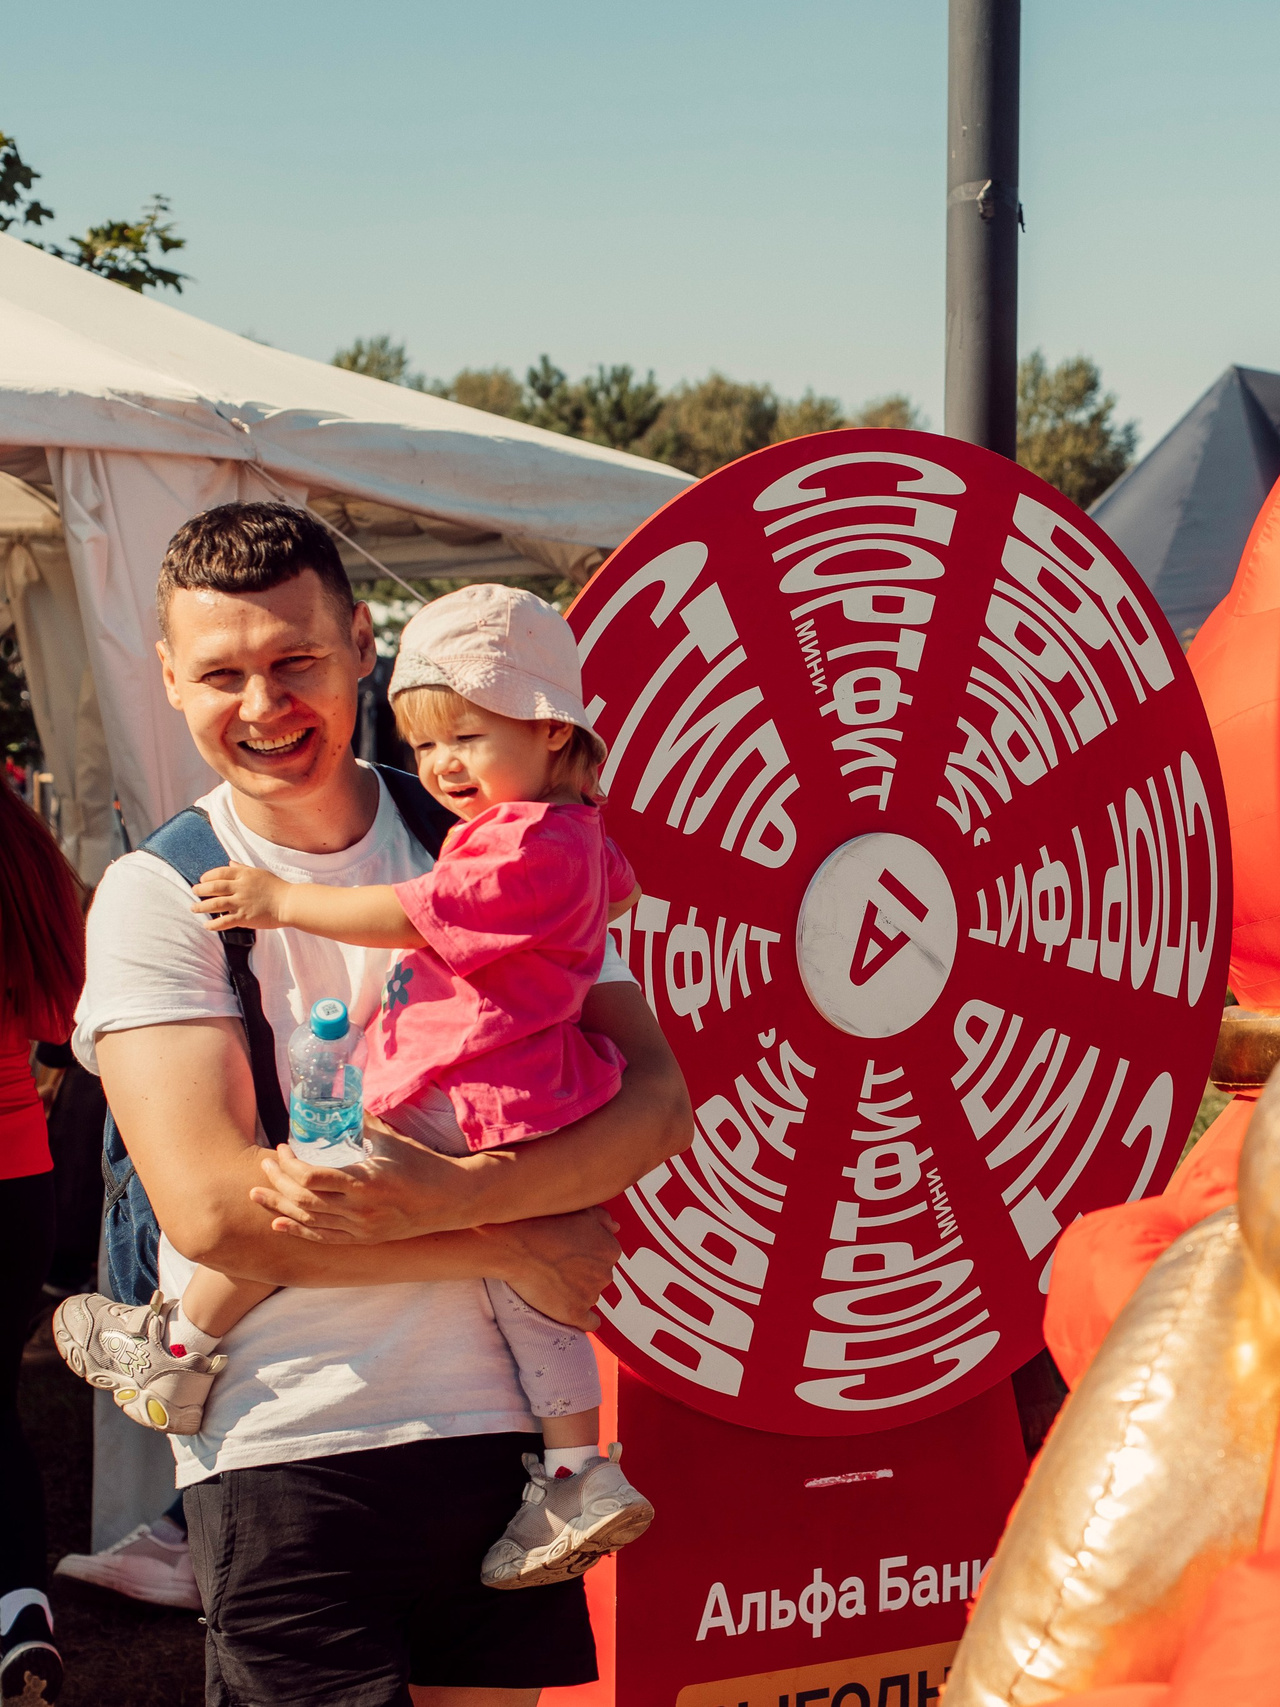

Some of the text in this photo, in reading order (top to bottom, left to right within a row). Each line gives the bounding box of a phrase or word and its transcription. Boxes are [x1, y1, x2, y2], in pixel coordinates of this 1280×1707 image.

[753, 452, 966, 811] СПОРТФИТ
[795, 619, 828, 695] МИНИ
[936, 493, 1175, 846] ВЫБИРАЙ
[607, 894, 781, 1032] ТФИТ
[969, 751, 1217, 1007] СПОРТФИТ
[294, 1102, 343, 1124] AQUA
[926, 1168, 958, 1239] МИНИ
[597, 1028, 816, 1397] ВЫБИРАЙ
[795, 1060, 1000, 1411] СПОРТФИТ
[696, 1568, 866, 1641] Альфа
